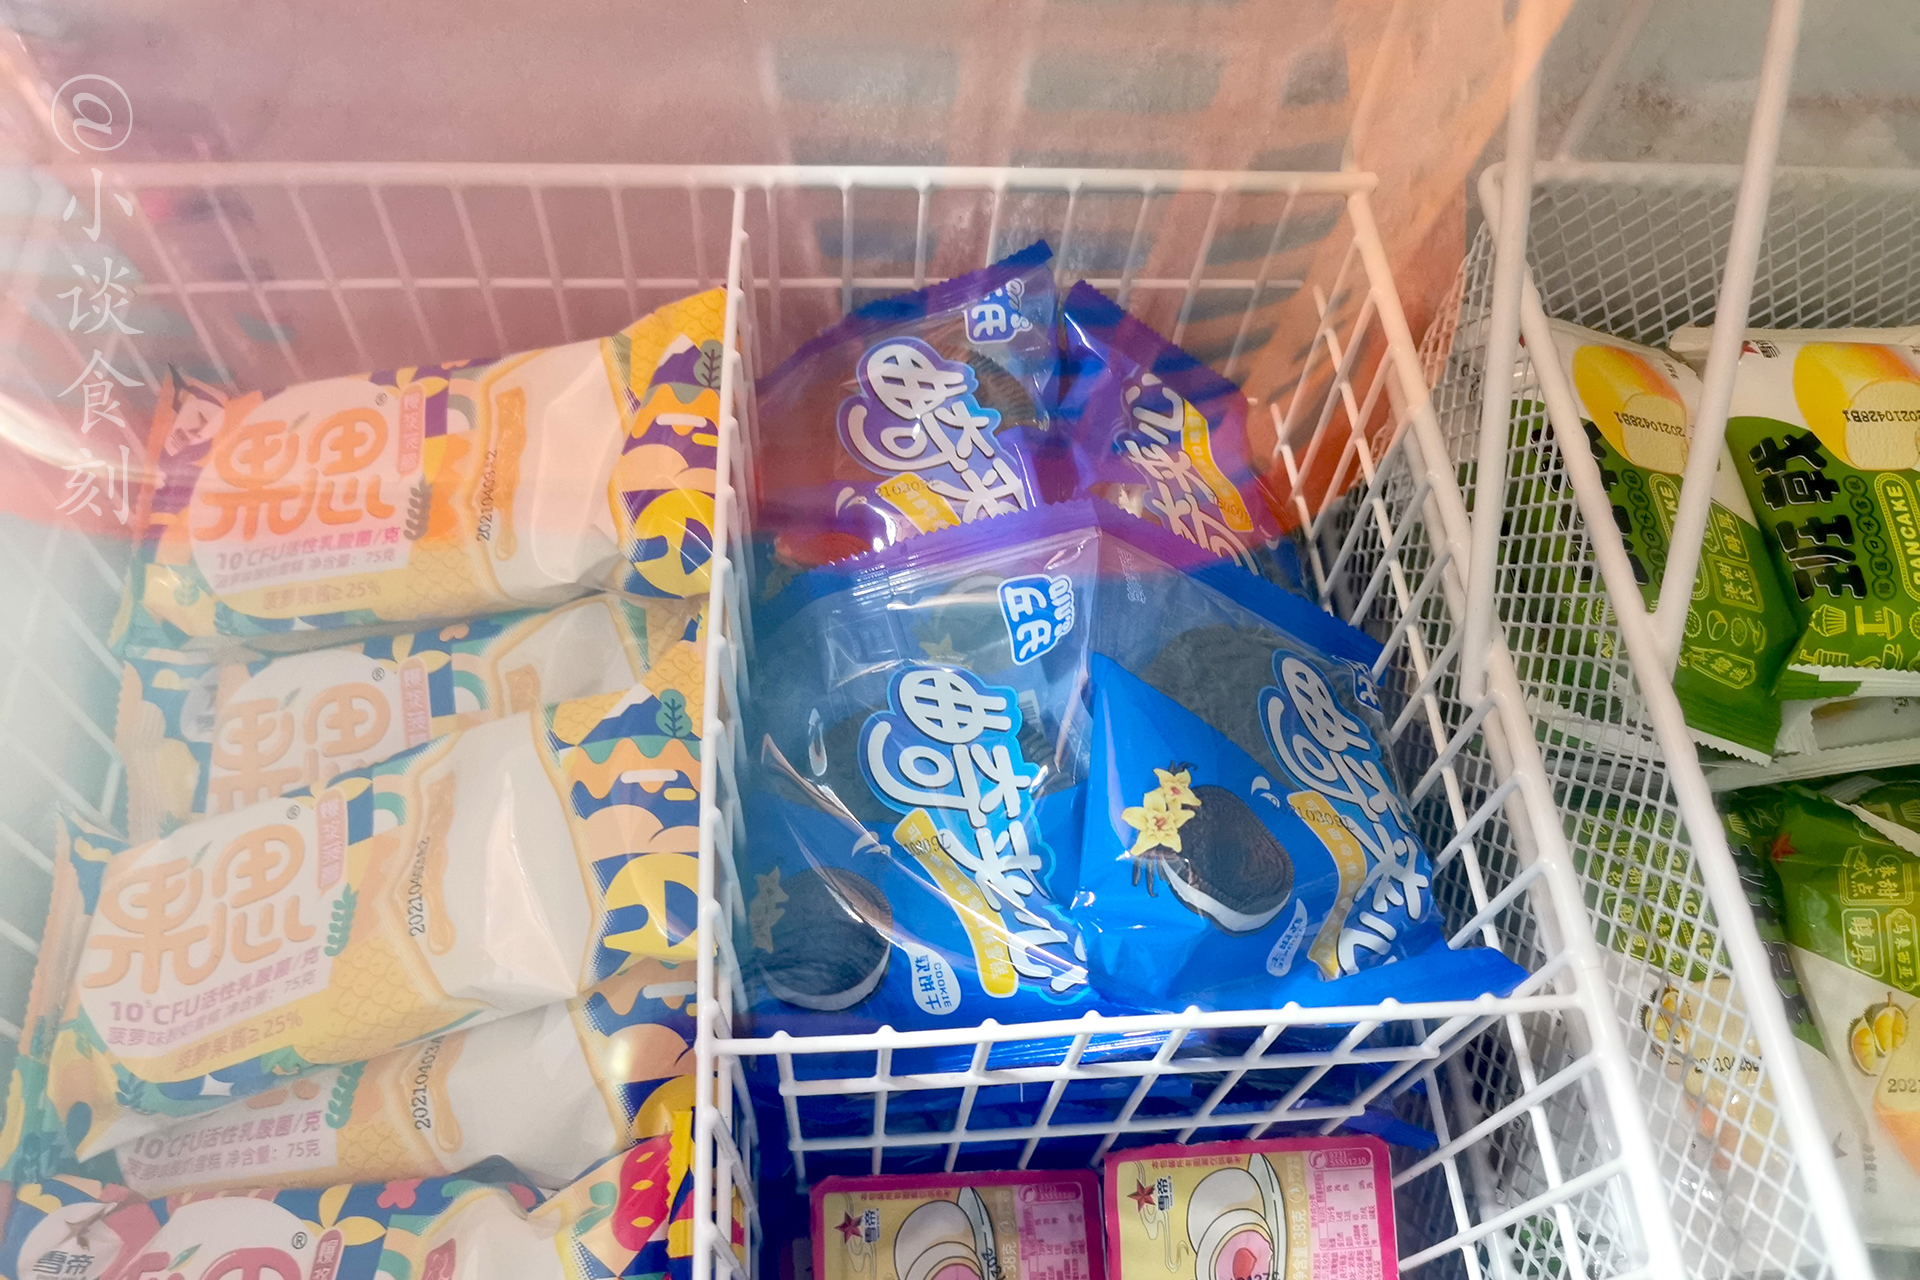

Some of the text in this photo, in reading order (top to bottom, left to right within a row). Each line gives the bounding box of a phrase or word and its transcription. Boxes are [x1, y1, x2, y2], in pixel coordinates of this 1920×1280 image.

[193, 407, 396, 543] 果思
[81, 824, 318, 994] 果思
[933, 962, 953, 1008] COOKIE
[32, 1250, 95, 1276] 雪帝
